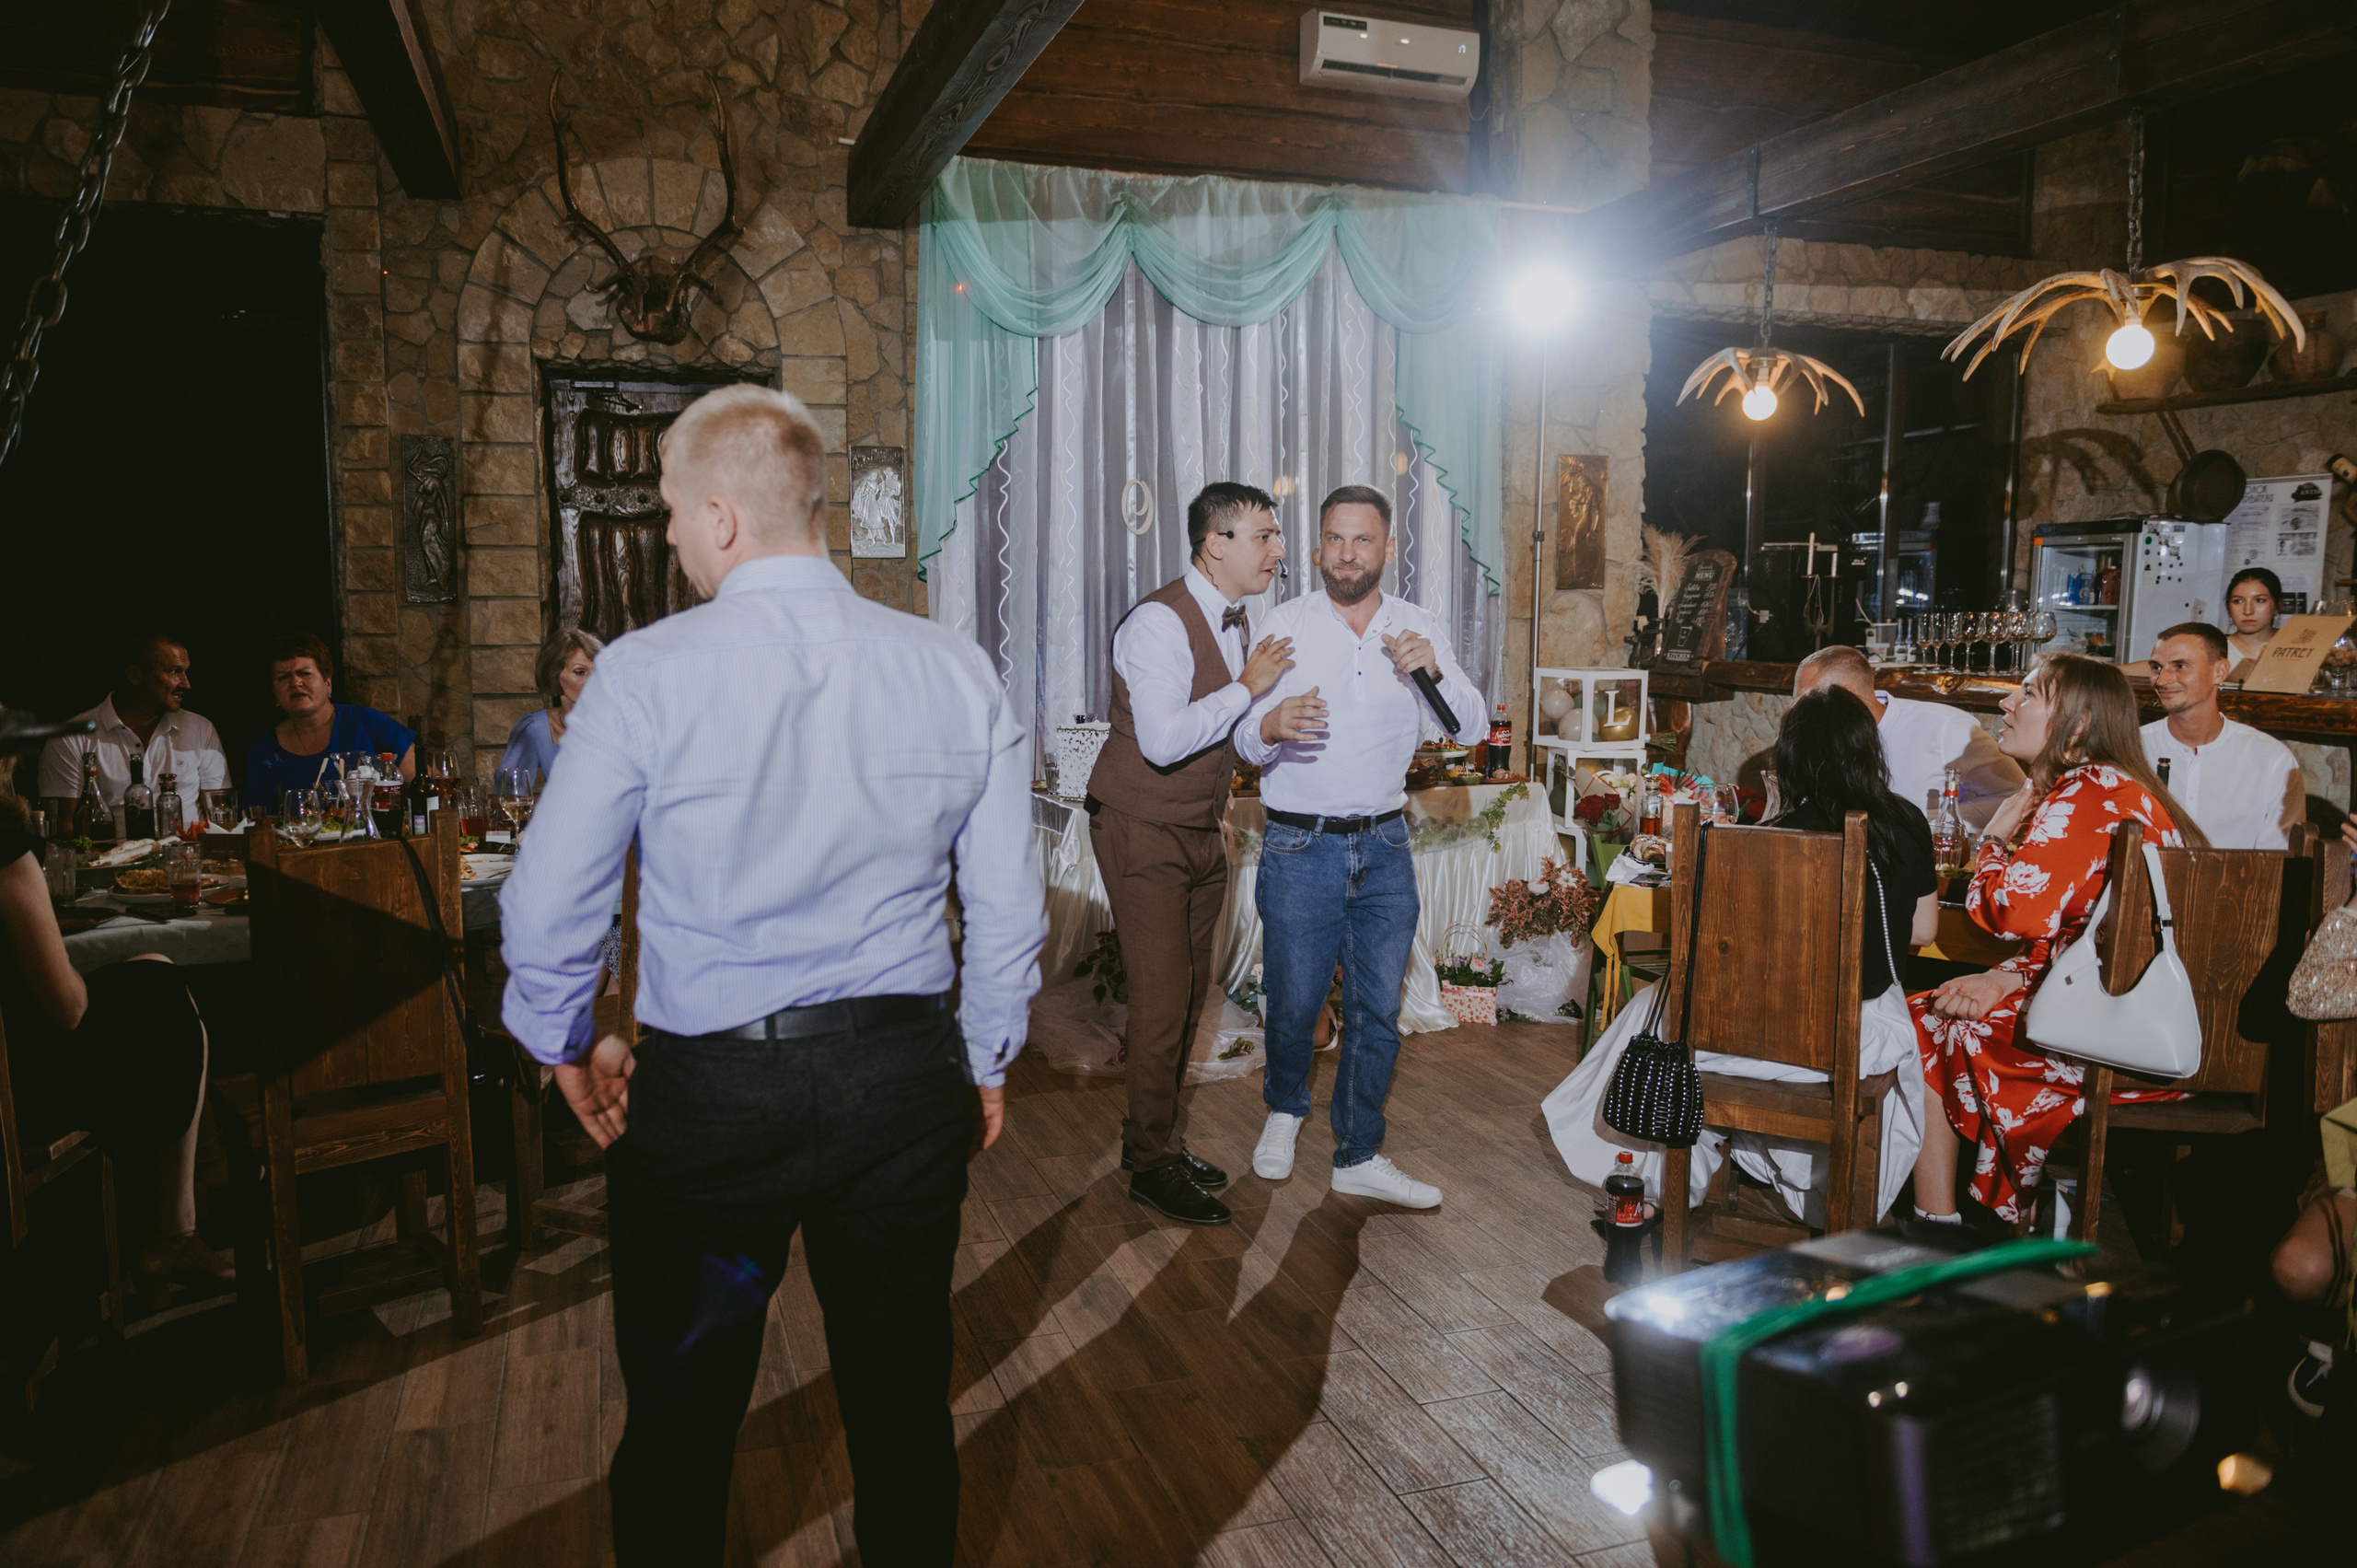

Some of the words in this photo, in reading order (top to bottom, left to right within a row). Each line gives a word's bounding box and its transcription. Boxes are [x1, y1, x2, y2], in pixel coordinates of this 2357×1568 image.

[1694, 572, 1715, 580] MENU
[1666, 652, 1691, 660] KITCHEN
[2271, 646, 2316, 658] PATREY
[1603, 690, 1632, 727] L
